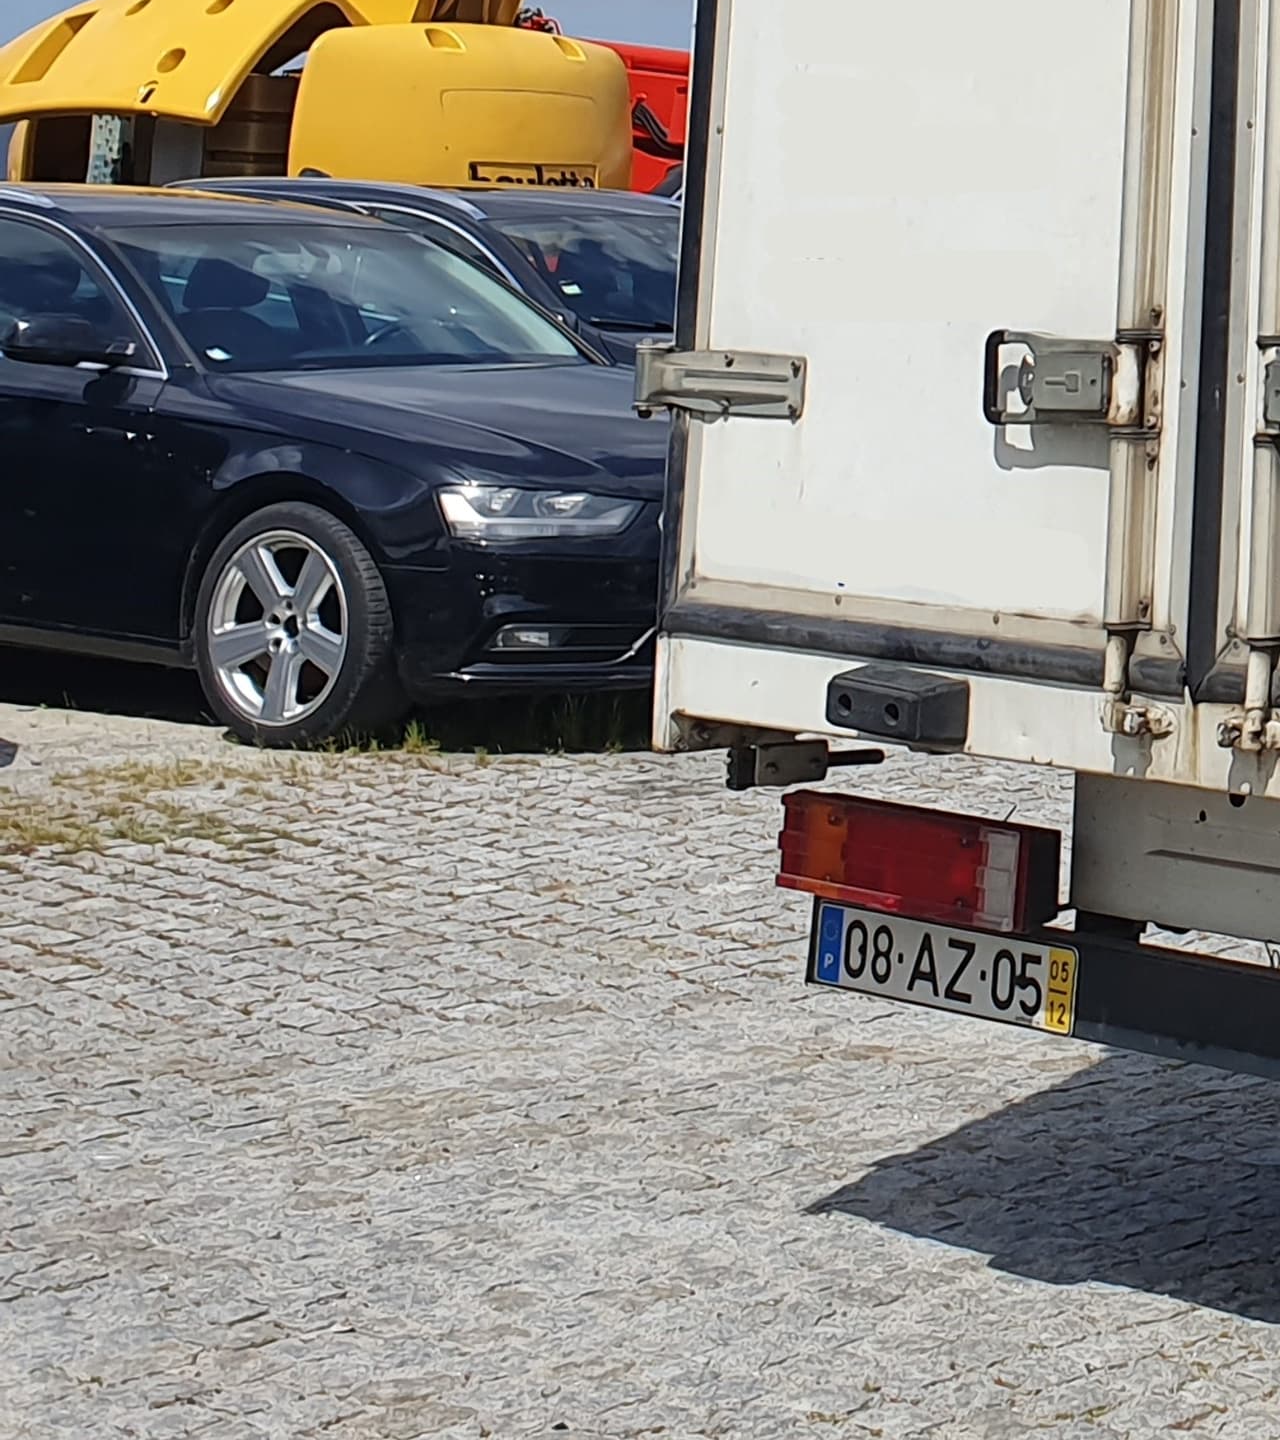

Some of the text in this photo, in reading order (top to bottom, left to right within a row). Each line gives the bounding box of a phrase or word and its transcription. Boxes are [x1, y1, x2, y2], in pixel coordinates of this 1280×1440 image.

[823, 952, 835, 969] P
[1050, 960, 1069, 983] 05
[1049, 1000, 1066, 1026] 12
